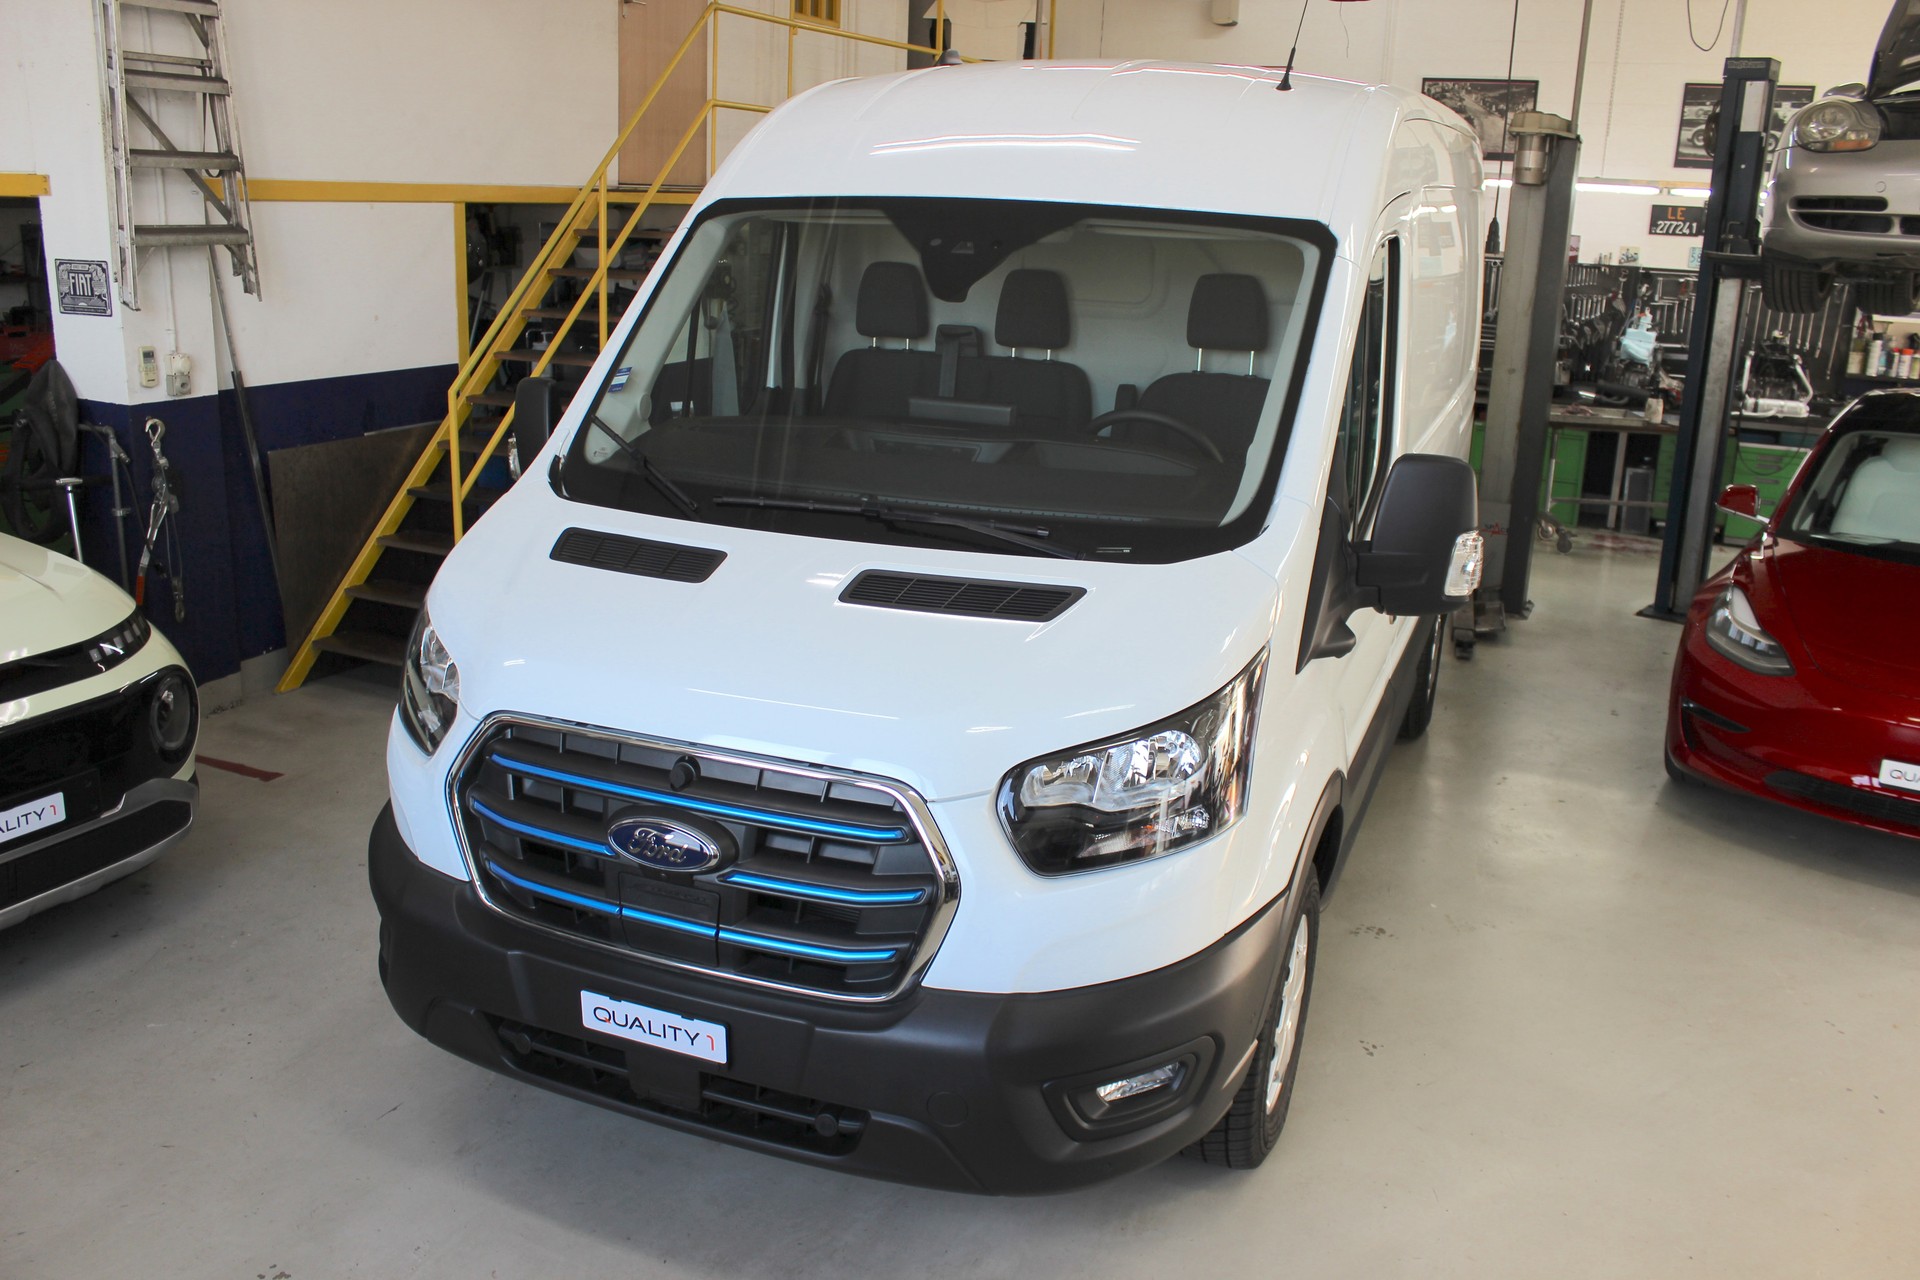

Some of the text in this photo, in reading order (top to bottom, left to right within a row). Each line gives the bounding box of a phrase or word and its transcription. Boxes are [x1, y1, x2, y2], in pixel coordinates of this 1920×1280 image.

[1667, 206, 1686, 220] LE
[1656, 220, 1698, 235] 277241
[69, 272, 92, 296] FIAT
[1890, 769, 1920, 783] QU
[49, 804, 57, 816] 1
[627, 827, 688, 864] Ford
[593, 1006, 715, 1052] QUALITY 1
